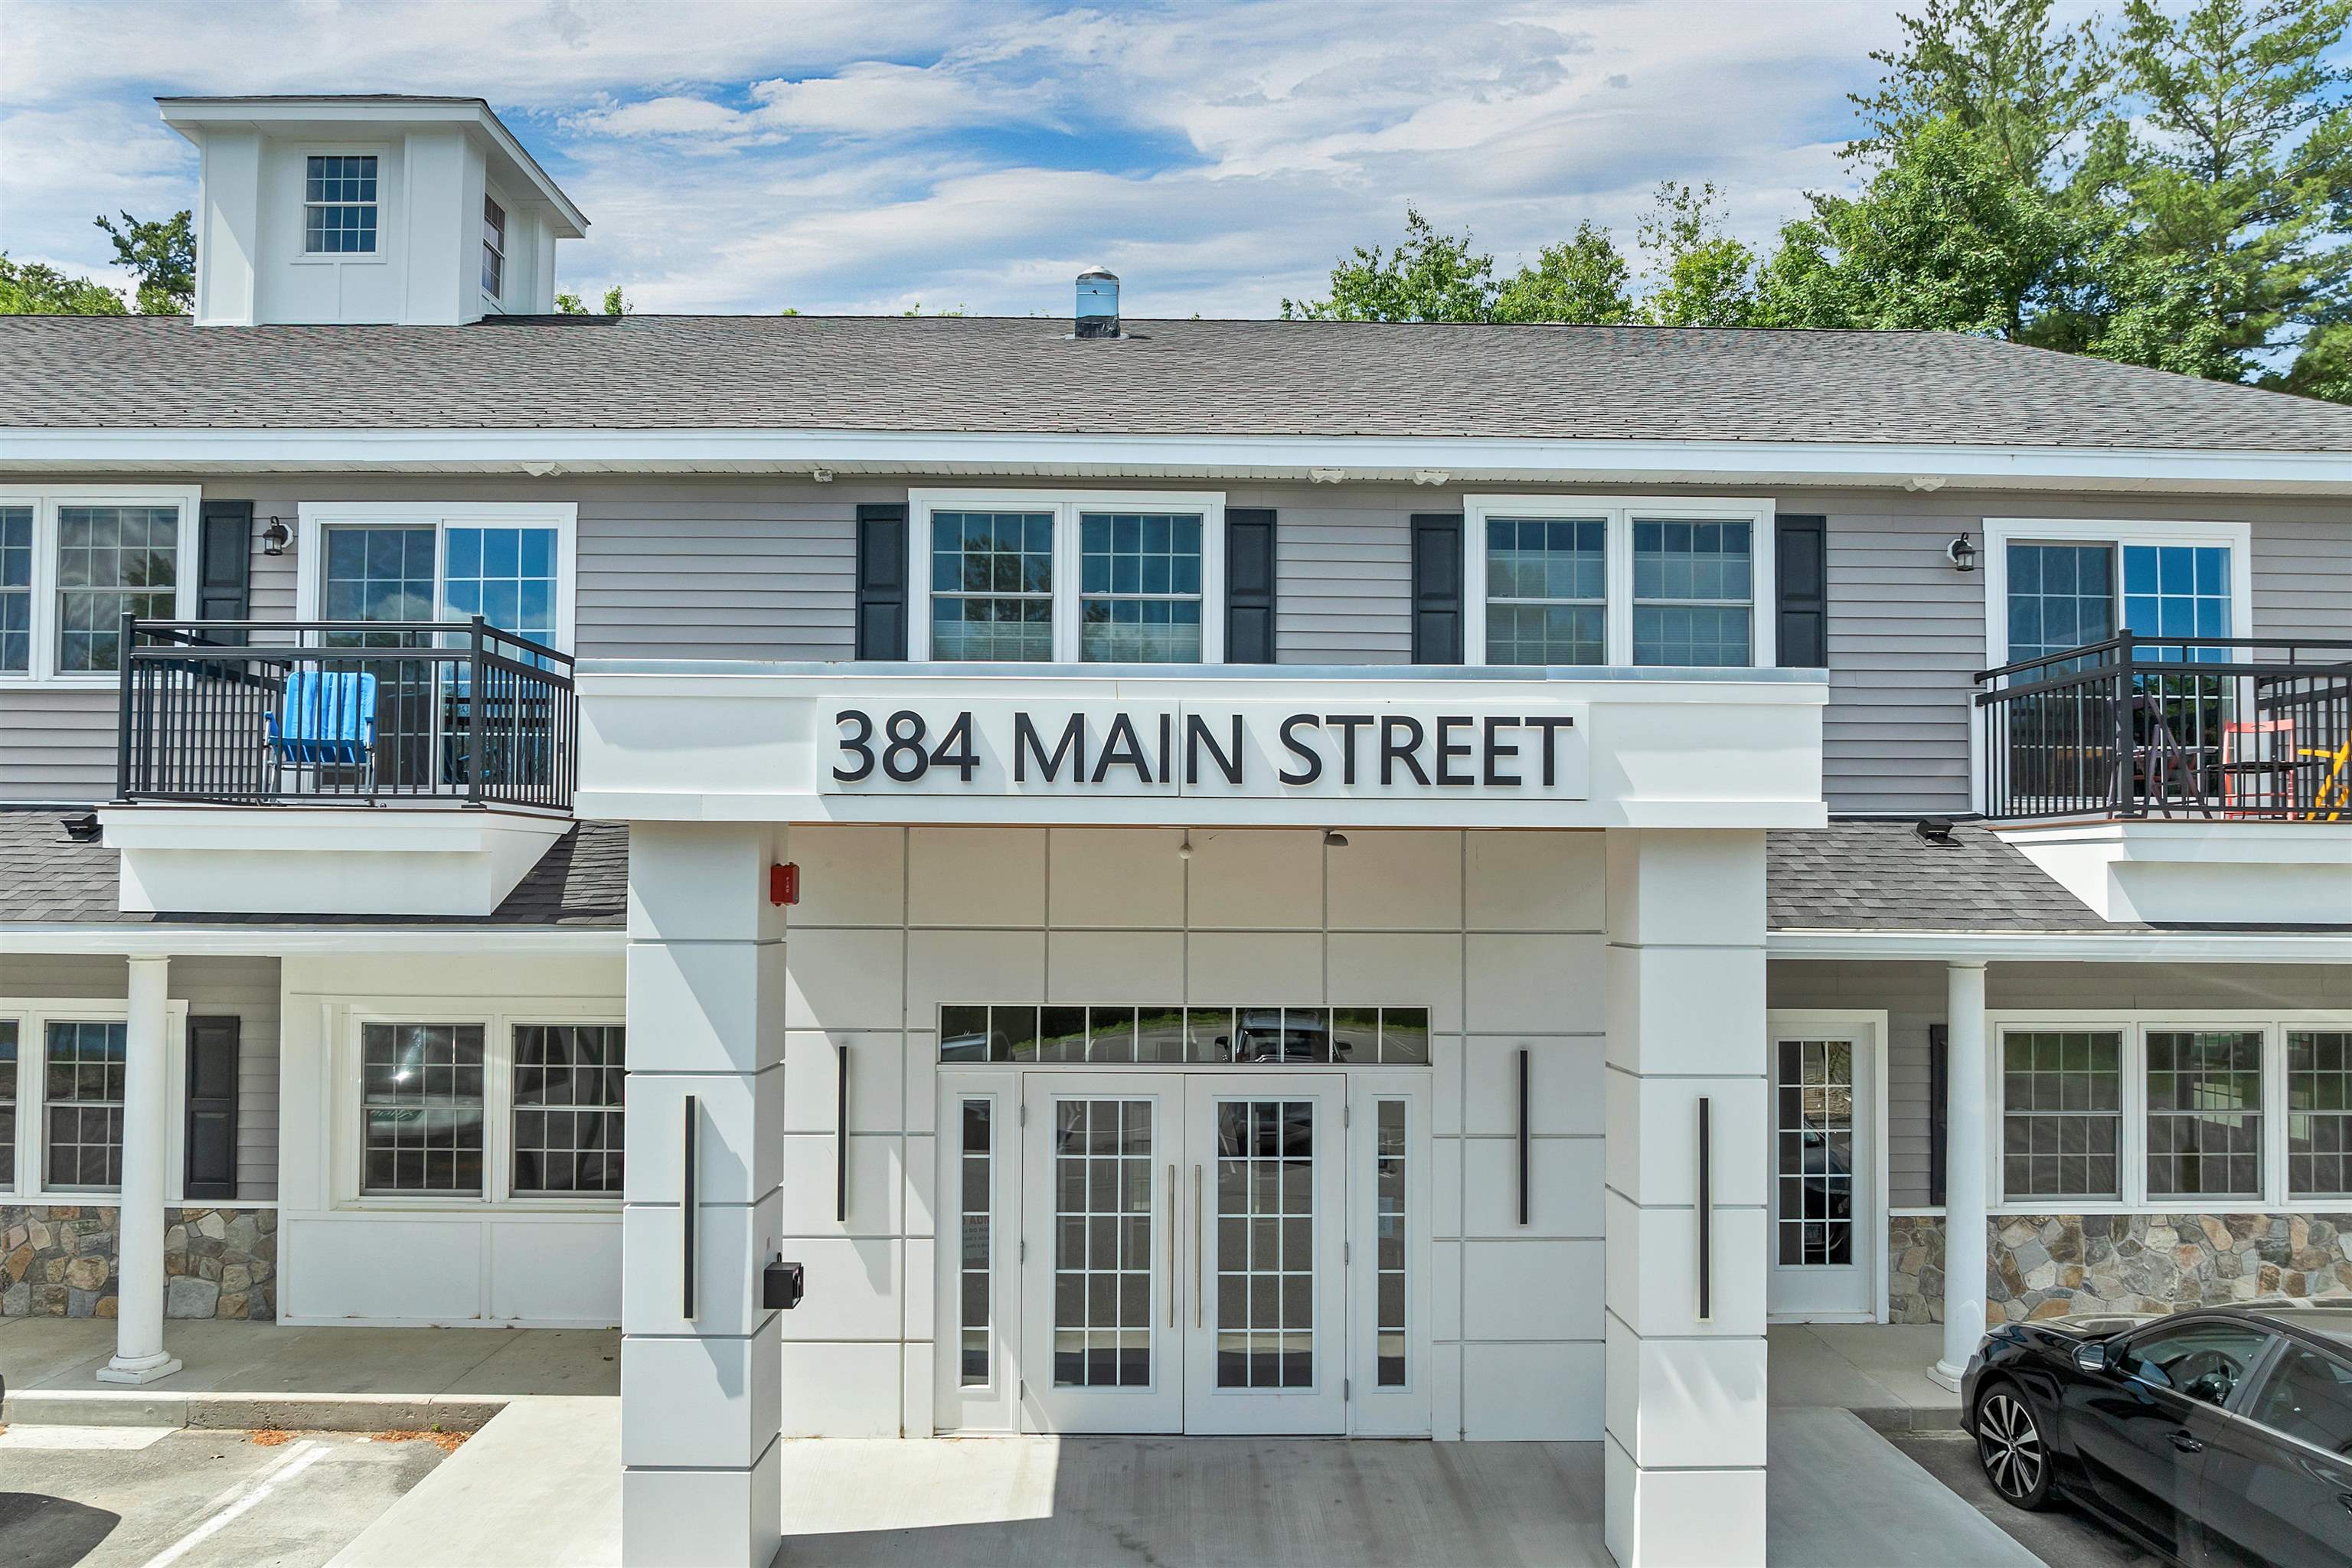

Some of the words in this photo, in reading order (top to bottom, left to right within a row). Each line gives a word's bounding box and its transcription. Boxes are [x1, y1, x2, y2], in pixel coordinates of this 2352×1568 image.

[832, 710, 981, 783] 384
[1014, 712, 1243, 785] MAIN
[1279, 714, 1574, 786] STREET
